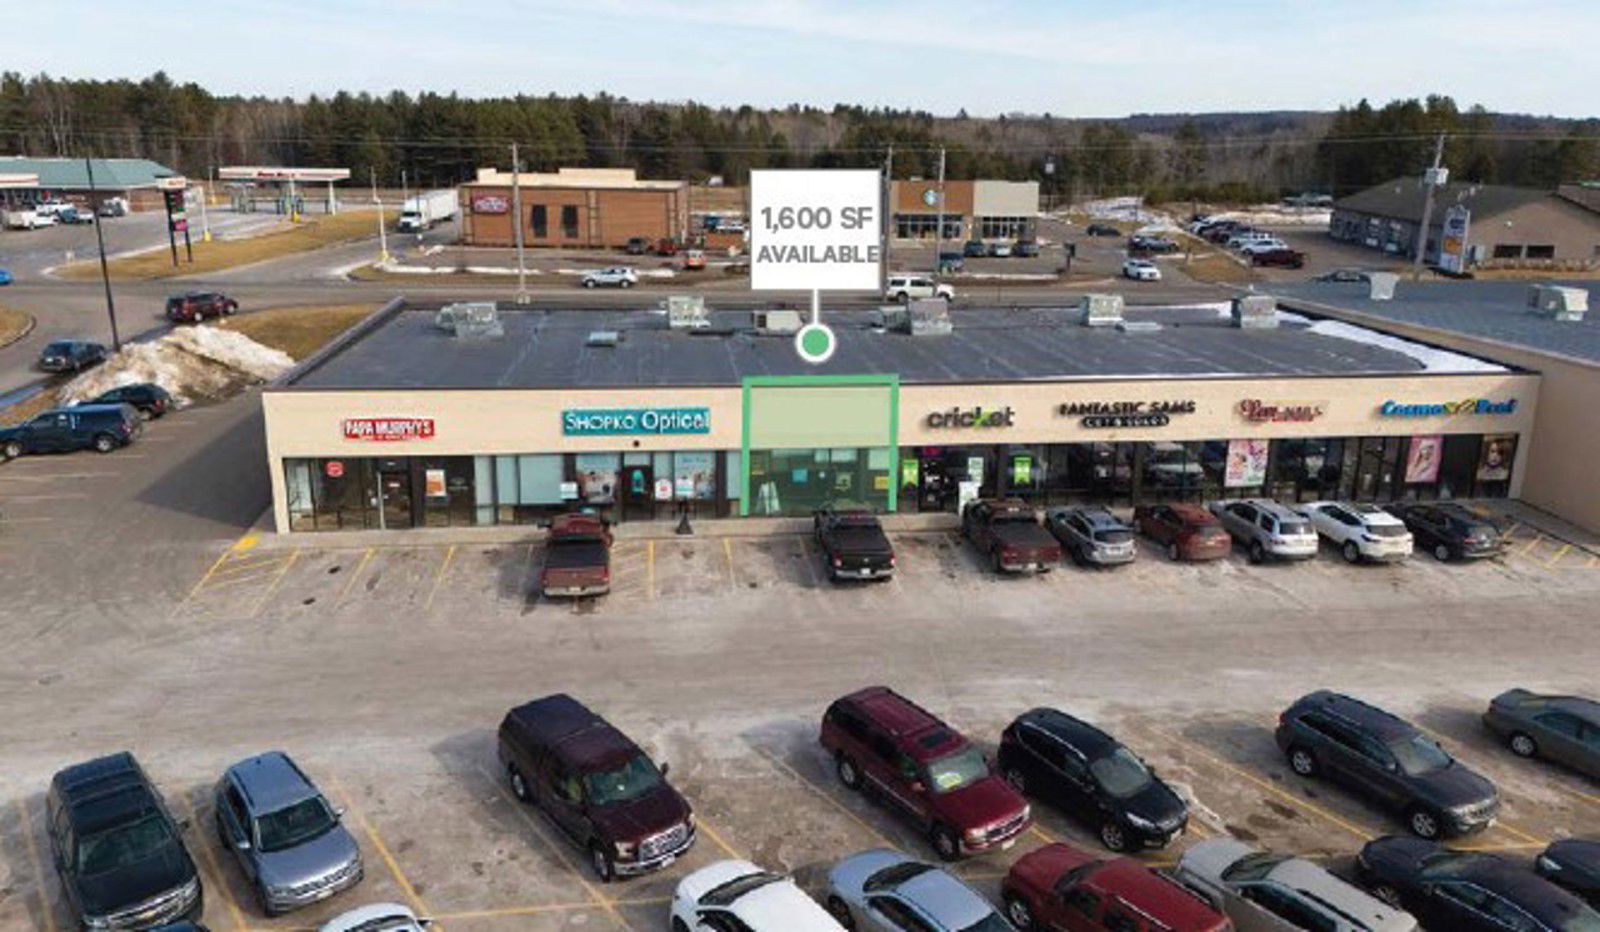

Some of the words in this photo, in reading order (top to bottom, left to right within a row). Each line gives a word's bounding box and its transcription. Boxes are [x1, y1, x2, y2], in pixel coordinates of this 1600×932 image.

[927, 406, 1015, 428] cricket
[1059, 402, 1145, 415] FANTASTIC
[1149, 400, 1196, 414] SAMS
[641, 410, 710, 434] Optical
